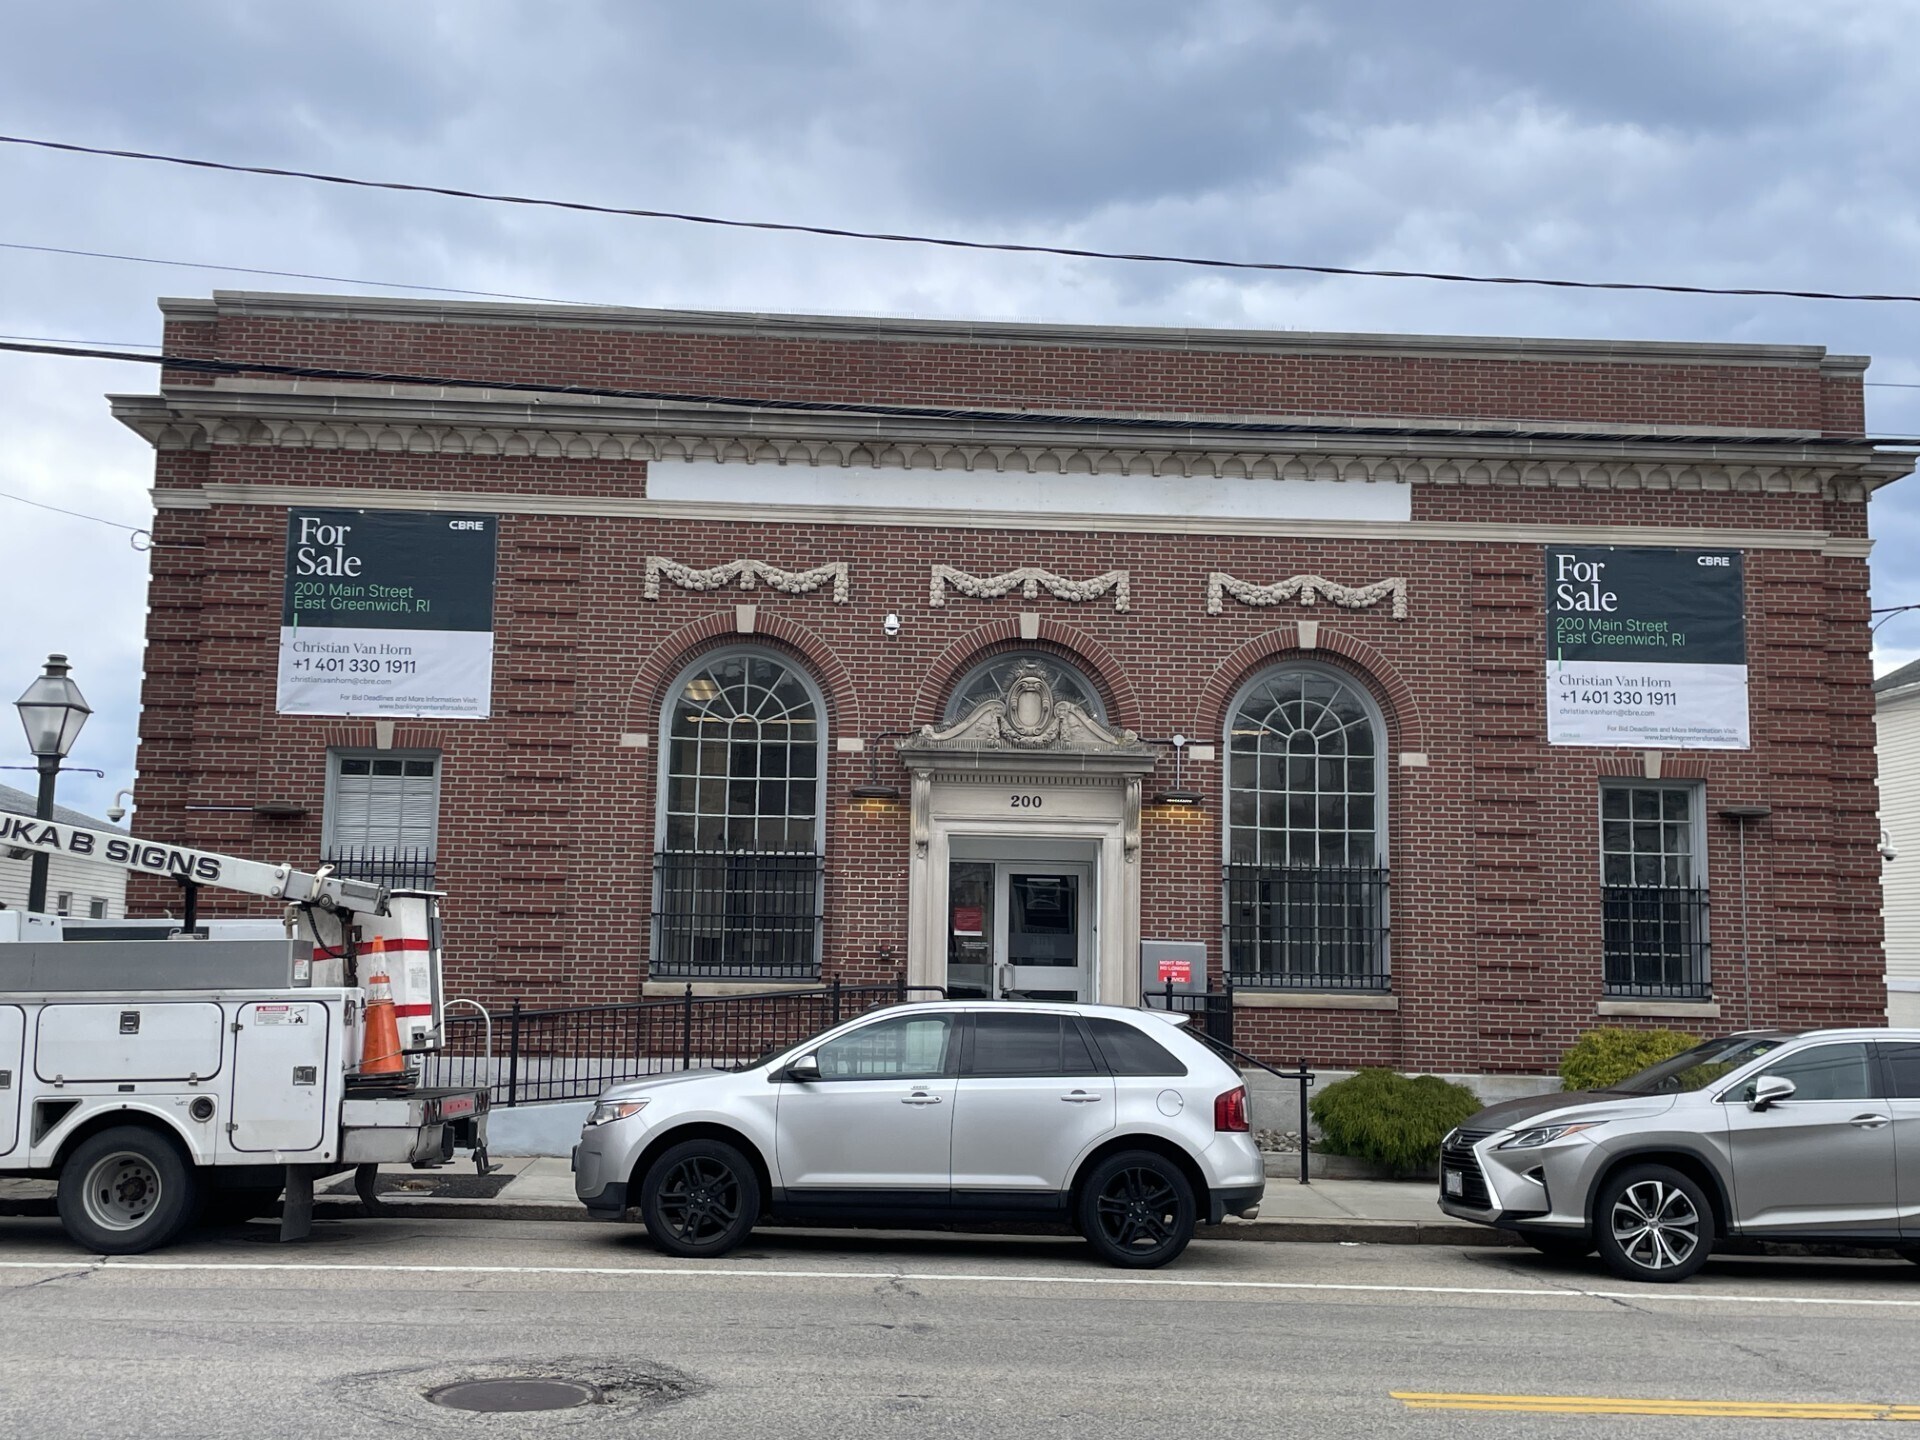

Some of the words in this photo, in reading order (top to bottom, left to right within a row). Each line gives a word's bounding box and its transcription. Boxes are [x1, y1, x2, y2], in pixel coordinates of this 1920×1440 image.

[297, 517, 351, 546] For
[449, 520, 484, 531] CBRE
[296, 546, 362, 577] Sale
[1556, 554, 1605, 582] For
[1697, 556, 1730, 567] CBRE
[294, 582, 325, 596] 200
[329, 583, 365, 597] Main
[368, 584, 414, 599] Street
[1556, 583, 1618, 612] Sale
[294, 596, 326, 610] East
[330, 597, 412, 614] Greenwich,
[416, 600, 431, 612] RI
[1556, 617, 1585, 631] 200
[1588, 618, 1623, 632] Main
[1626, 619, 1669, 633] Street
[1557, 631, 1587, 645] East
[1591, 631, 1668, 648] Greenwich,
[1672, 634, 1686, 646] RI
[292, 641, 350, 654] Christian
[353, 643, 377, 655] Van
[379, 644, 412, 656] Horn
[293, 658, 310, 671] +1
[315, 658, 345, 672] 401
[348, 659, 380, 673] 330
[384, 660, 416, 674] 1911
[1559, 674, 1613, 687] Christian
[1615, 676, 1638, 688] Van
[1641, 677, 1671, 688] Horn
[1560, 690, 1576, 704] +1
[1581, 690, 1608, 705] 401
[1613, 691, 1643, 705] 330
[1647, 692, 1677, 706] 1911
[1559, 708, 1655, 717] christian.vanhorn@cbre.com
[1629, 725, 1659, 733] Deadlines
[1688, 726, 1722, 734] Information
[1010, 795, 1042, 808] 200
[68, 830, 96, 855] B
[105, 839, 221, 880] SIGNS
